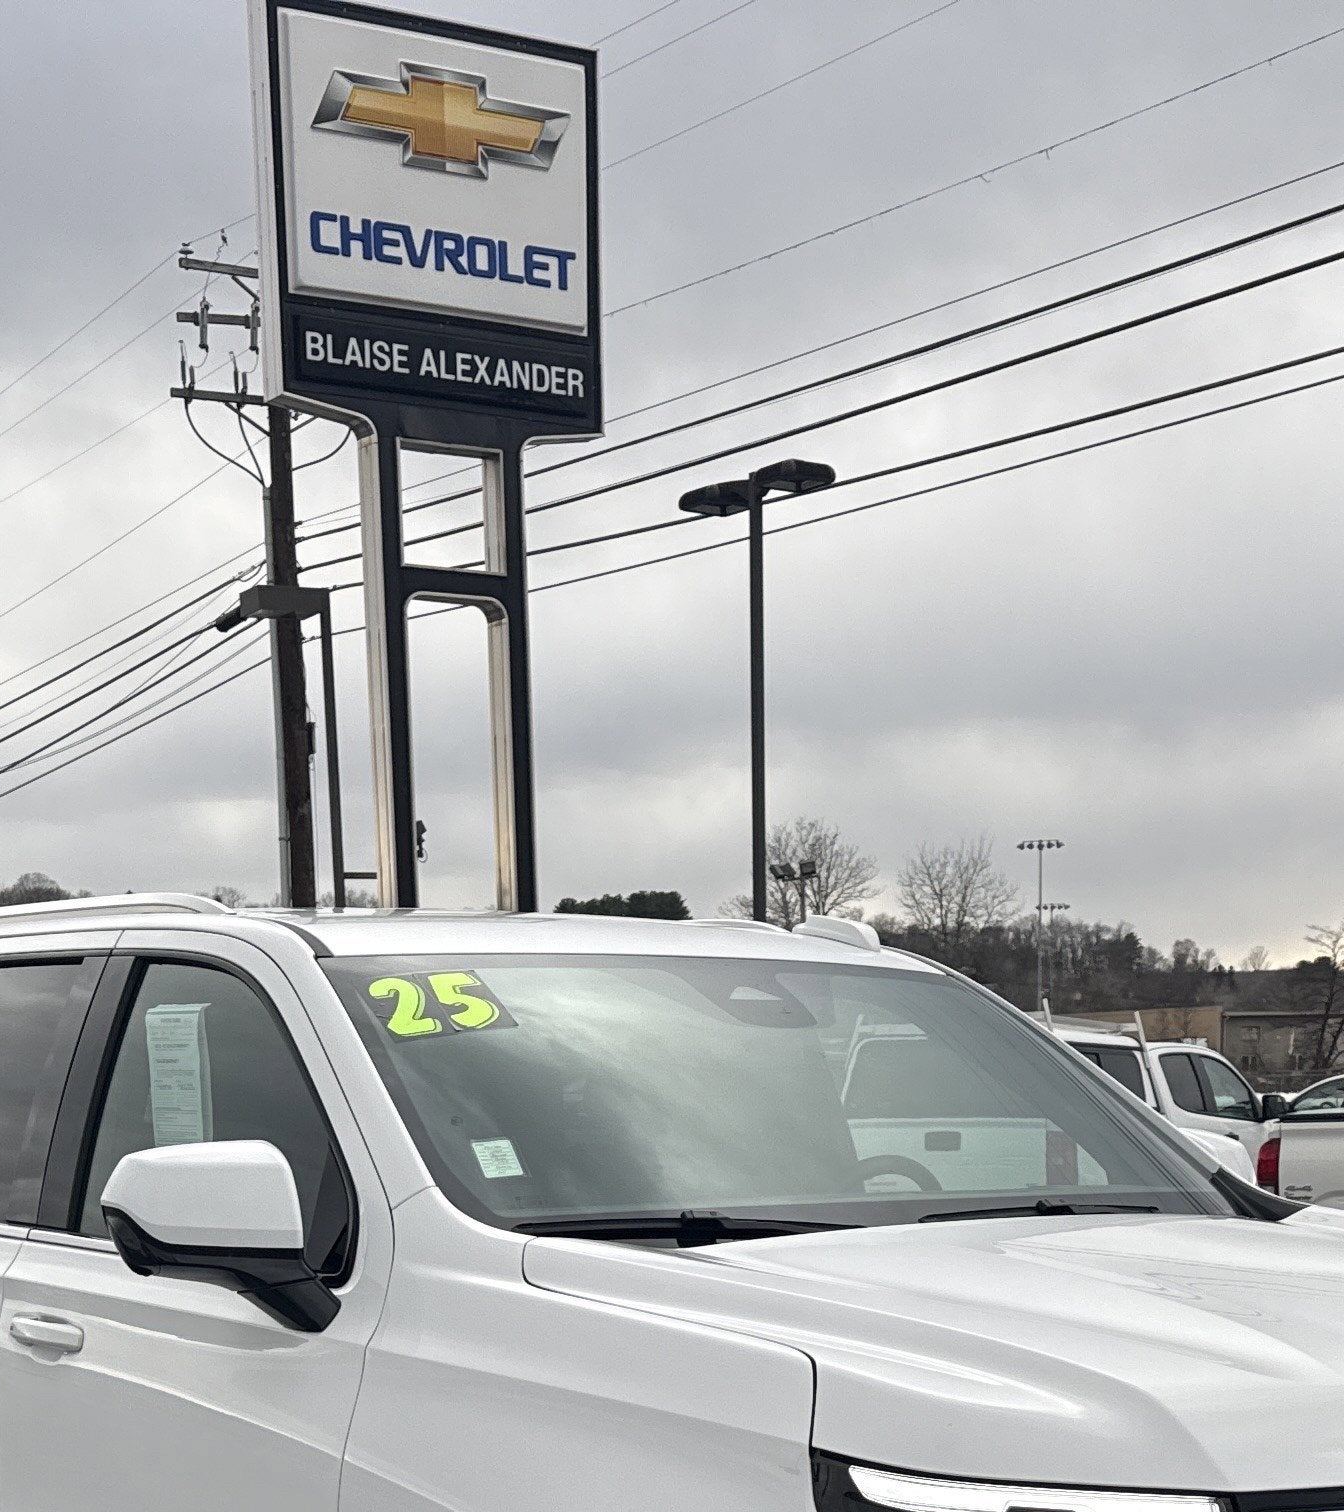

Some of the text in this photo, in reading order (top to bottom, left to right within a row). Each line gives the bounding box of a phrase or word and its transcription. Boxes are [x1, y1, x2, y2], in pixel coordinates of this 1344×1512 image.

[310, 211, 576, 291] CHEVROLET
[304, 330, 585, 398] BLAISE ALEXANDER
[368, 970, 500, 1038] 25
